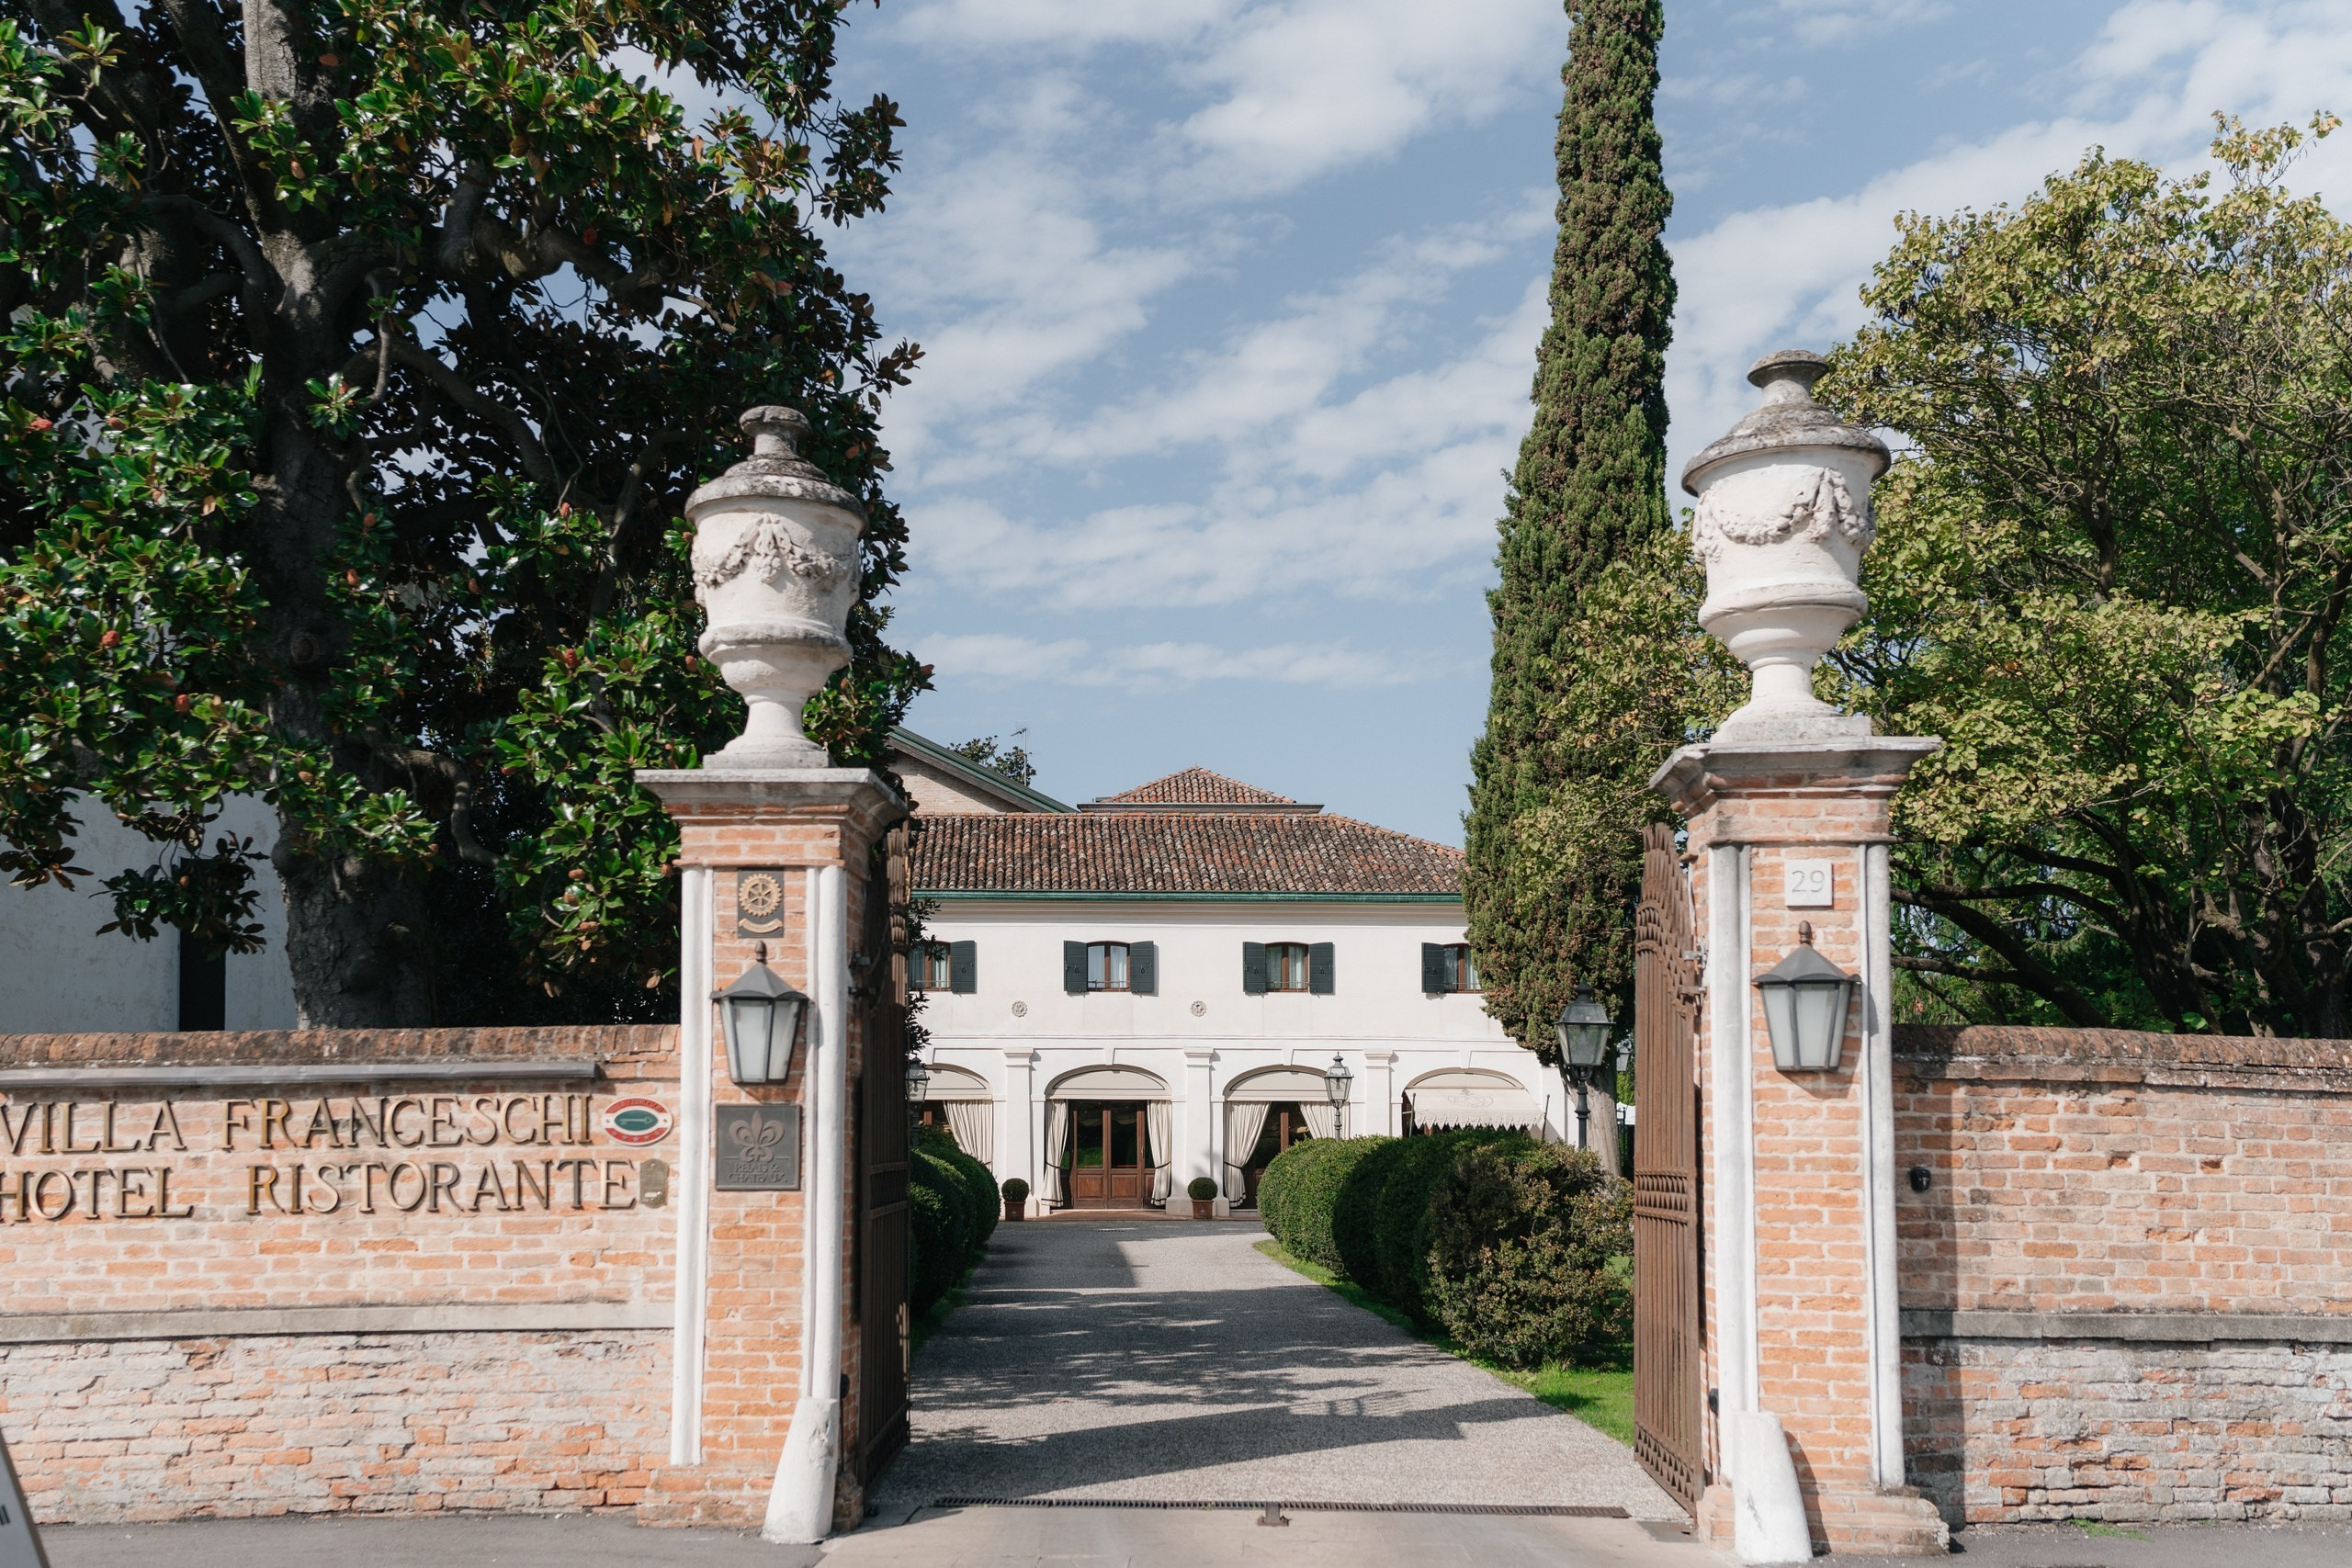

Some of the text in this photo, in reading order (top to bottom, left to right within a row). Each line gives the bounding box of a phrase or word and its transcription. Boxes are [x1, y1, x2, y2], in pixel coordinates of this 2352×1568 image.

[1791, 870, 1825, 893] 29
[0, 1094, 594, 1155] VILLA FRANCESCHI
[734, 1162, 780, 1173] RELAIS &
[0, 1165, 195, 1224] HOTEL
[245, 1158, 638, 1216] RISTORANTE
